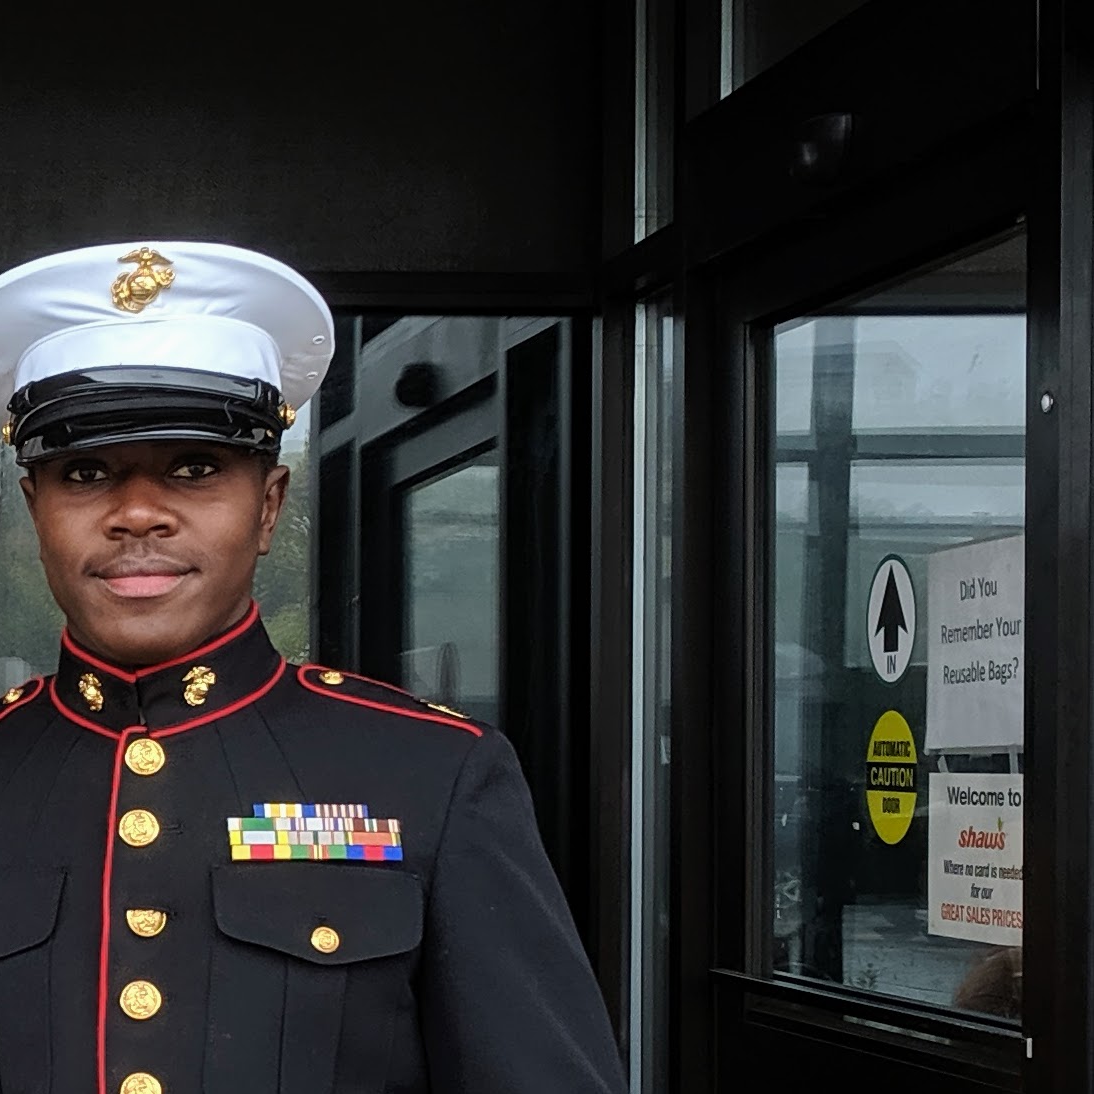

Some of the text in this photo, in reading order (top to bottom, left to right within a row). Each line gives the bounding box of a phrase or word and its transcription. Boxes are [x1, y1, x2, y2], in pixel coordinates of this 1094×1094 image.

[959, 577, 998, 601] Did You
[941, 616, 1022, 644] Remember Your
[886, 655, 897, 674] IN
[943, 657, 1019, 685] Reusable Bags?
[873, 741, 911, 757] AUTOMATIC
[870, 766, 914, 788] CAUTION
[947, 786, 1022, 807] Welcome to
[965, 864, 974, 877] no
[975, 863, 990, 878] card
[991, 867, 997, 878] is
[971, 883, 994, 900] for our
[941, 902, 965, 922] GREAT
[966, 905, 991, 926] SALES
